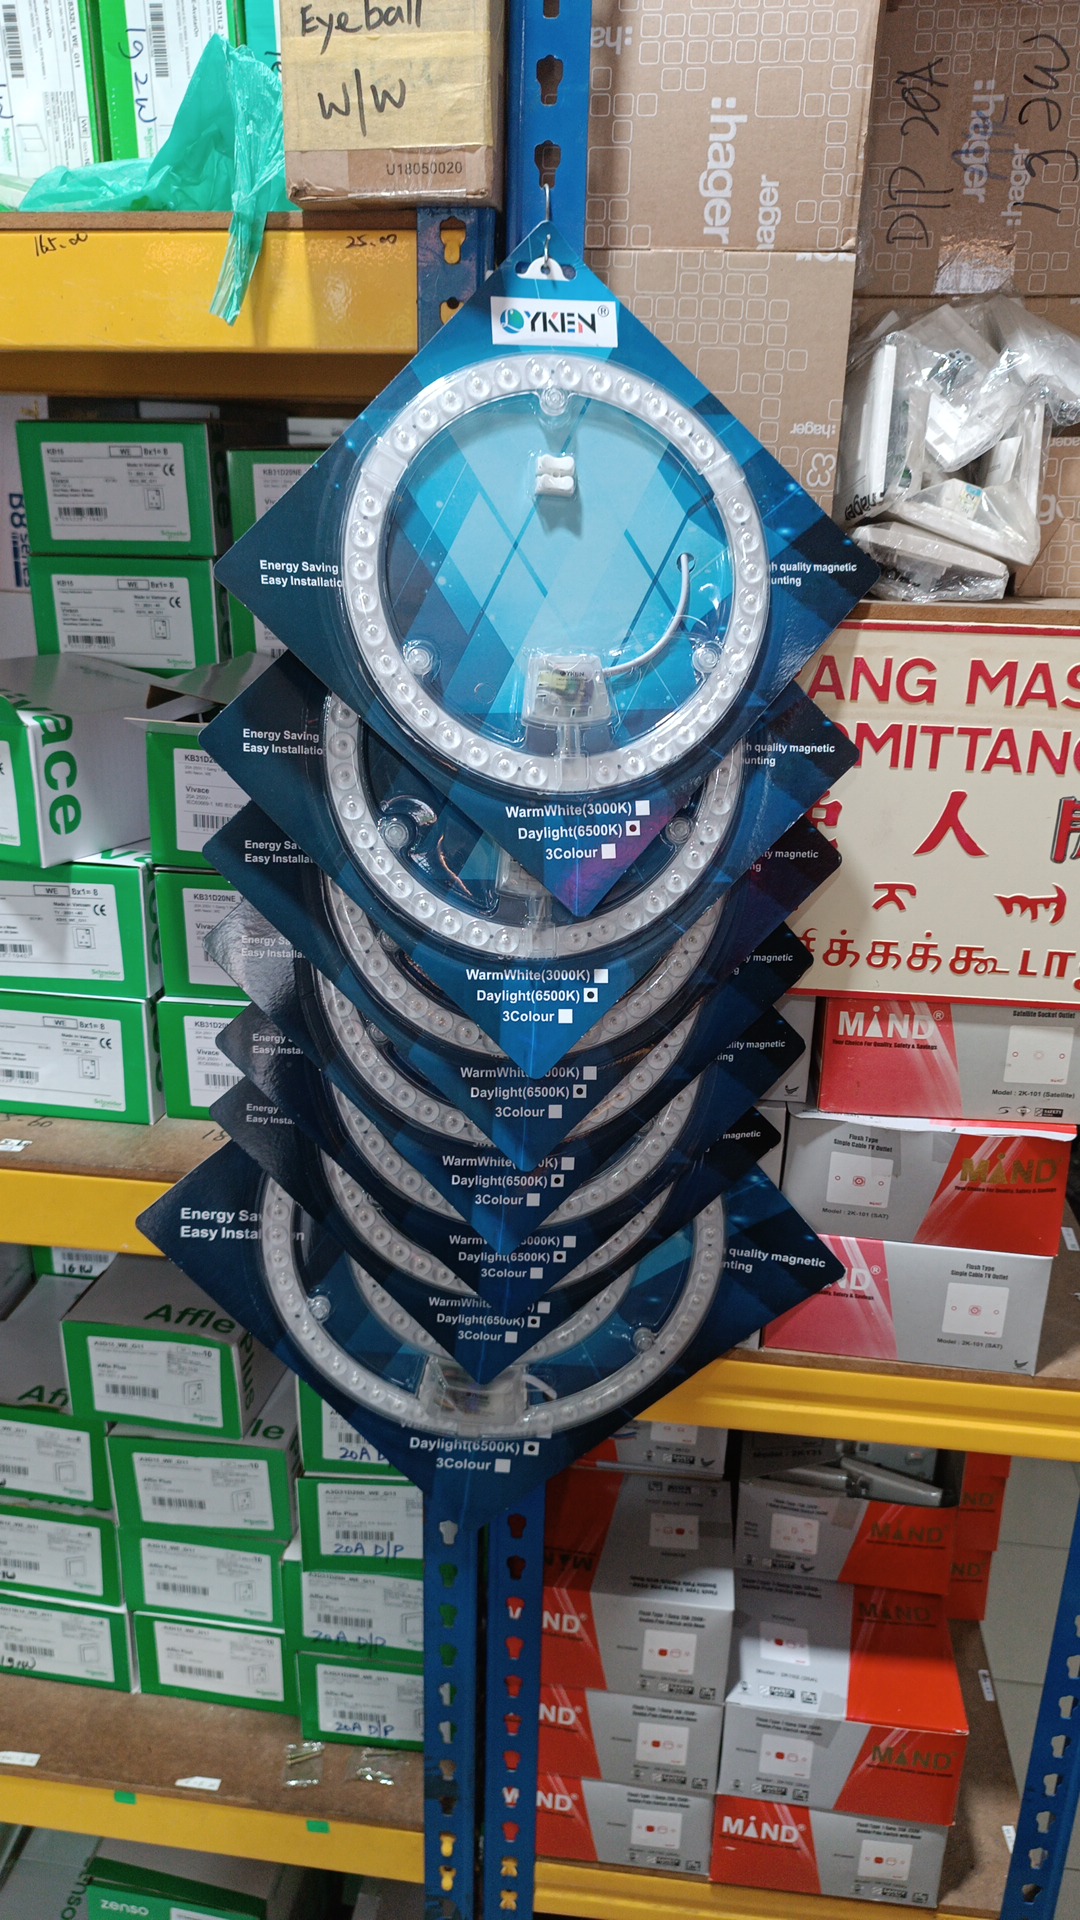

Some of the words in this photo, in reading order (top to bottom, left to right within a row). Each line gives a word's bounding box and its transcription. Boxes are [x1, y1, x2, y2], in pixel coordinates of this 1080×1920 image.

[301, 0, 423, 55] Eyeball
[317, 68, 406, 137] W/W
[386, 163, 463, 176] U18050020
[755, 173, 782, 250] ager
[259, 559, 299, 573] Energy
[301, 561, 340, 575] Saving
[779, 562, 812, 574] quality
[813, 562, 858, 574] magnetic
[260, 574, 288, 588] Easy
[290, 575, 343, 588] Installatio
[806, 655, 937, 705] ANG
[242, 728, 281, 742] Energy
[283, 730, 320, 744] Saving
[242, 742, 269, 755] Easy
[271, 743, 324, 756] Installatio
[754, 743, 788, 755] quality
[789, 743, 836, 755] magnetic
[833, 720, 1080, 777] MITTAN
[185, 785, 210, 795] Vivace
[505, 802, 632, 819] WarmWhite(3000K)
[517, 823, 623, 841] Daylight(6500K)
[244, 840, 282, 852] Energy
[244, 853, 271, 865] Easy
[545, 847, 599, 861] 3Colour
[774, 849, 819, 860] magnetic
[241, 935, 276, 947] Energy
[241, 947, 266, 959] Easy
[752, 953, 794, 962] magnetic
[466, 968, 591, 983] WarmWhite(3000K)
[476, 988, 580, 1004] Daylight(6500K)
[502, 1010, 555, 1023] 3Colour
[1012, 1010, 1037, 1018] Satellite
[252, 1033, 286, 1044] Energy
[746, 1039, 786, 1049] magnetic
[252, 1045, 276, 1056] Easy
[277, 1046, 304, 1055] Insta
[460, 1066, 580, 1079] WarmWhit00K)
[470, 1085, 570, 1100] Daylight(6500K)
[1043, 1090, 1076, 1099] (Satellite)
[246, 1103, 279, 1115] Energy
[494, 1106, 546, 1118] 3Colour
[246, 1114, 269, 1125] Easy
[270, 1115, 296, 1125] Insta
[722, 1130, 761, 1140] magnetic
[442, 1155, 558, 1170] WarmWhite(K)
[451, 1174, 548, 1189] Daylight(6500K)
[474, 1193, 524, 1206] 3Colour
[180, 1207, 235, 1223] Energy
[822, 1207, 842, 1215] Model
[180, 1225, 218, 1241] Easy
[457, 1251, 551, 1265] Daylight(6500K)
[728, 1248, 769, 1262] quality
[771, 1252, 826, 1269] magnetic
[481, 1268, 527, 1279] 3Colour
[457, 1331, 503, 1342] 3Colour
[936, 1337, 957, 1345] Model
[409, 1437, 521, 1456] Daylight(6500K)
[339, 1446, 372, 1461] 20A
[435, 1457, 492, 1471] 3Colour
[334, 1542, 365, 1554] 20A
[101, 1899, 149, 1916] zenso
